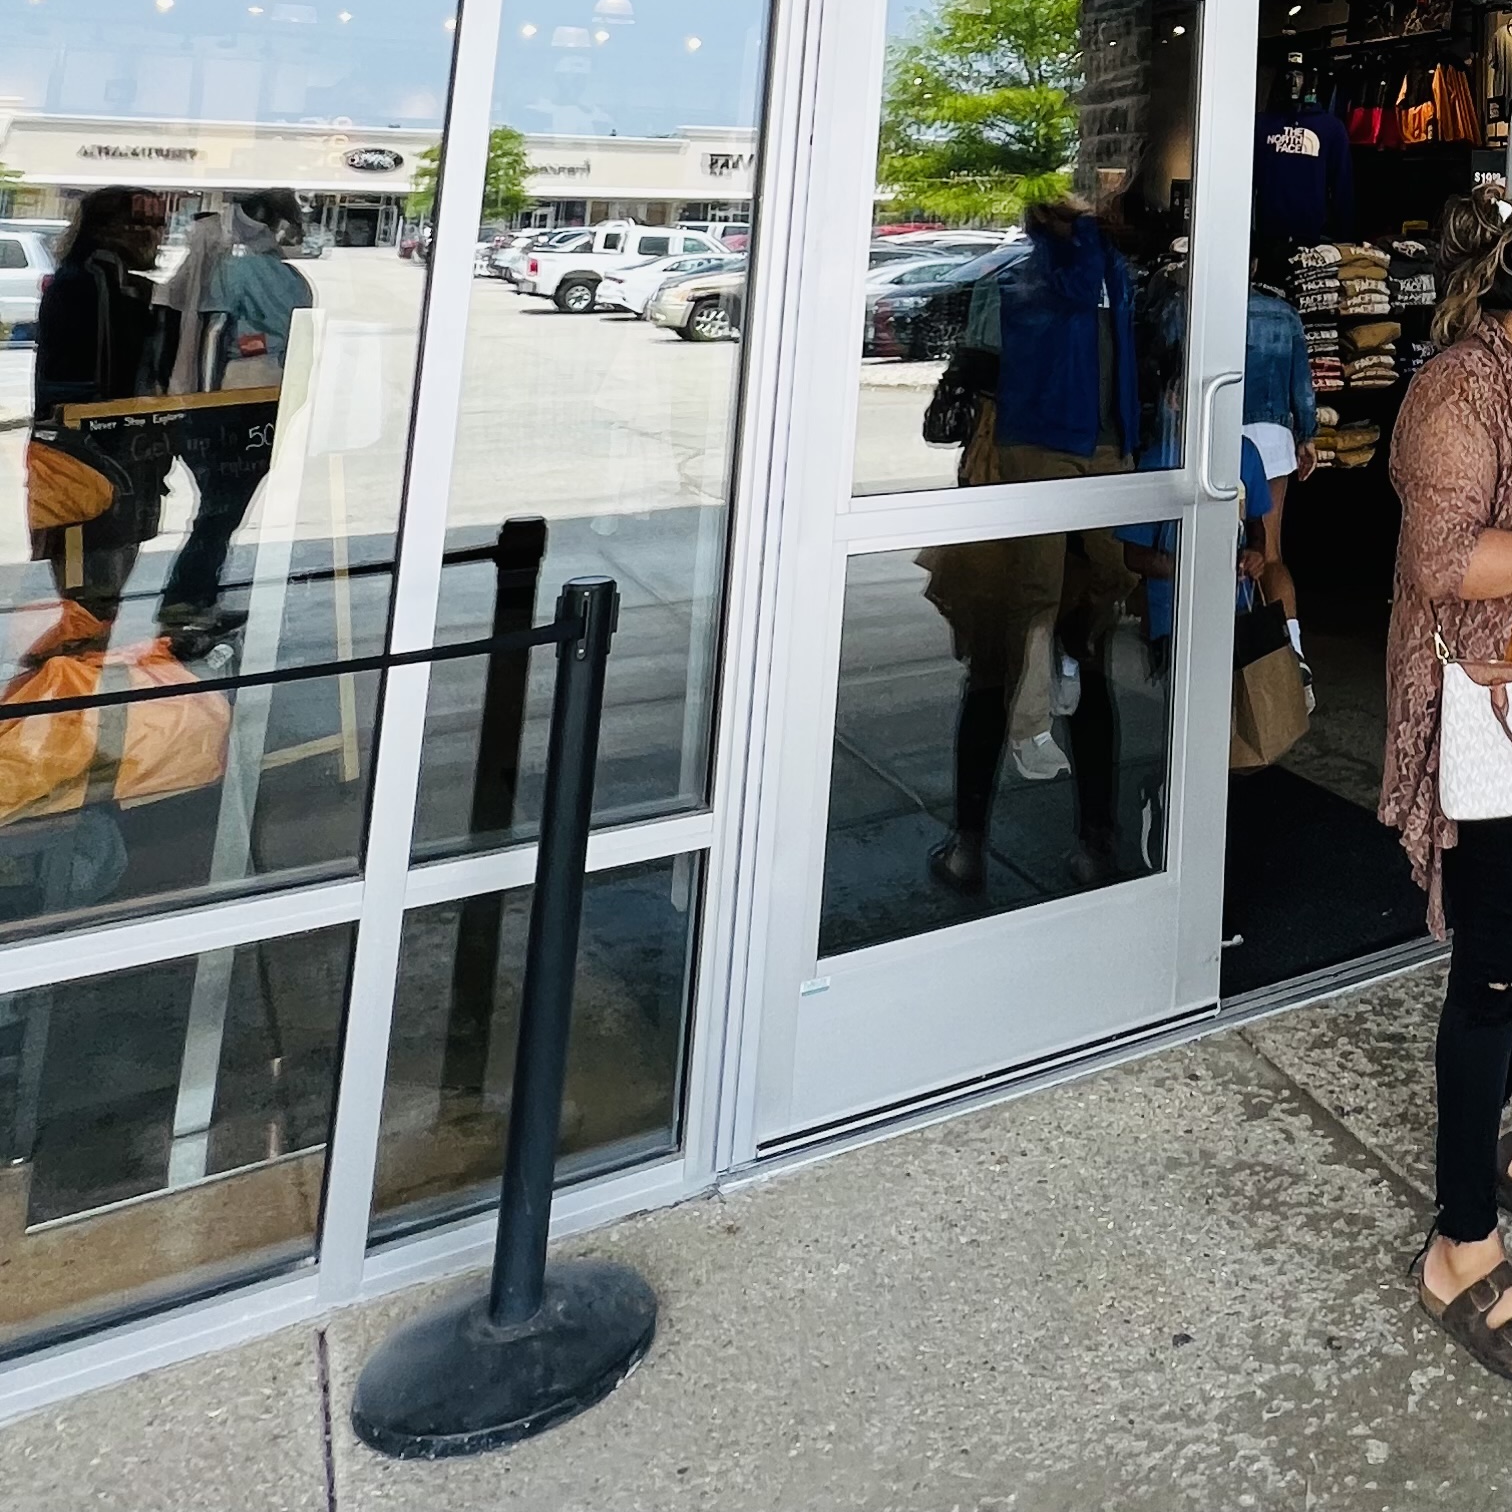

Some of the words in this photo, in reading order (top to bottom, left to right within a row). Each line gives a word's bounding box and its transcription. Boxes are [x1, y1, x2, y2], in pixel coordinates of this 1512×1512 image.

[1283, 126, 1304, 136] THE
[1266, 133, 1303, 145] NORTH
[1275, 142, 1303, 154] FACE
